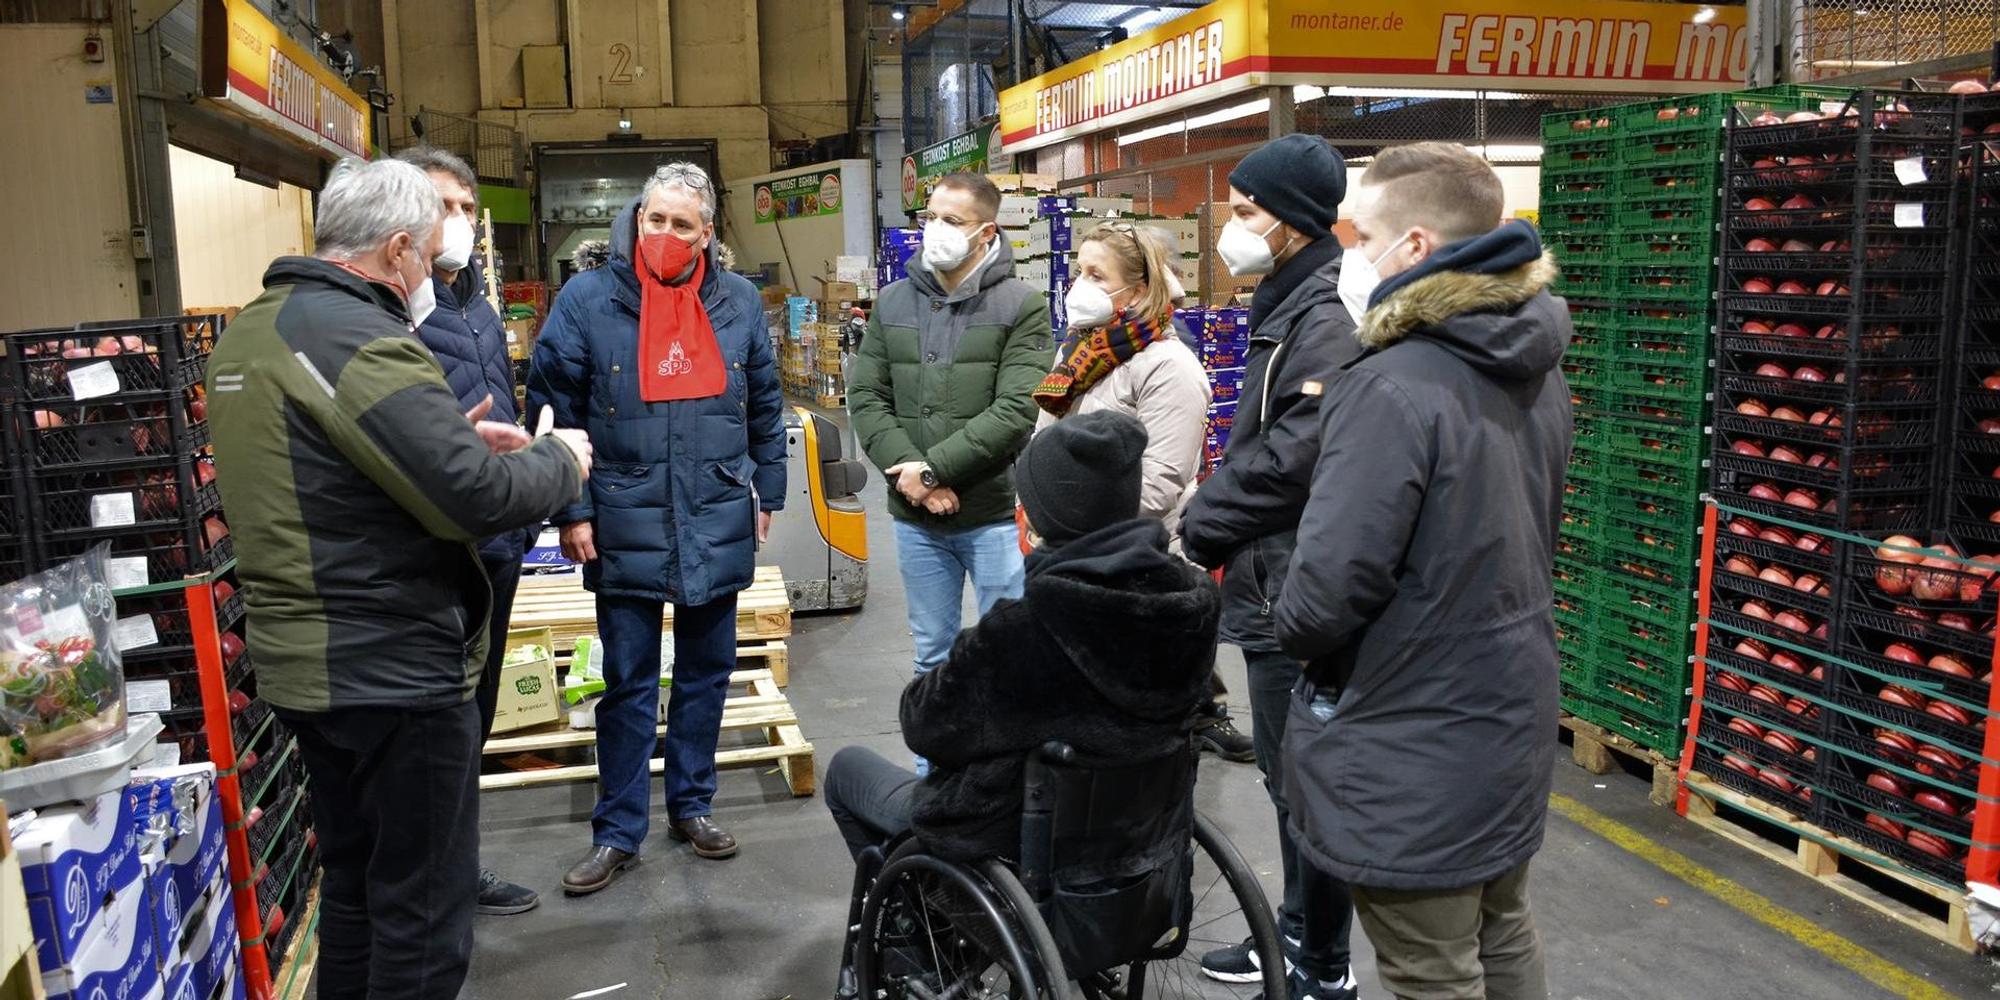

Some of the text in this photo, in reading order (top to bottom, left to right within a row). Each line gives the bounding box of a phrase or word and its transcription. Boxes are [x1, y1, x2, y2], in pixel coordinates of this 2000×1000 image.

[1290, 11, 1404, 31] montaner.de
[1435, 13, 1651, 78] FERMIN
[608, 43, 633, 84] 2
[1035, 18, 1224, 135] FERMIN MONTANER
[922, 141, 950, 167] FEINKOST
[952, 132, 979, 156] EGHBAL
[771, 178, 797, 192] FEINKOST
[798, 174, 820, 188] EGHBAL
[658, 358, 692, 376] SPD
